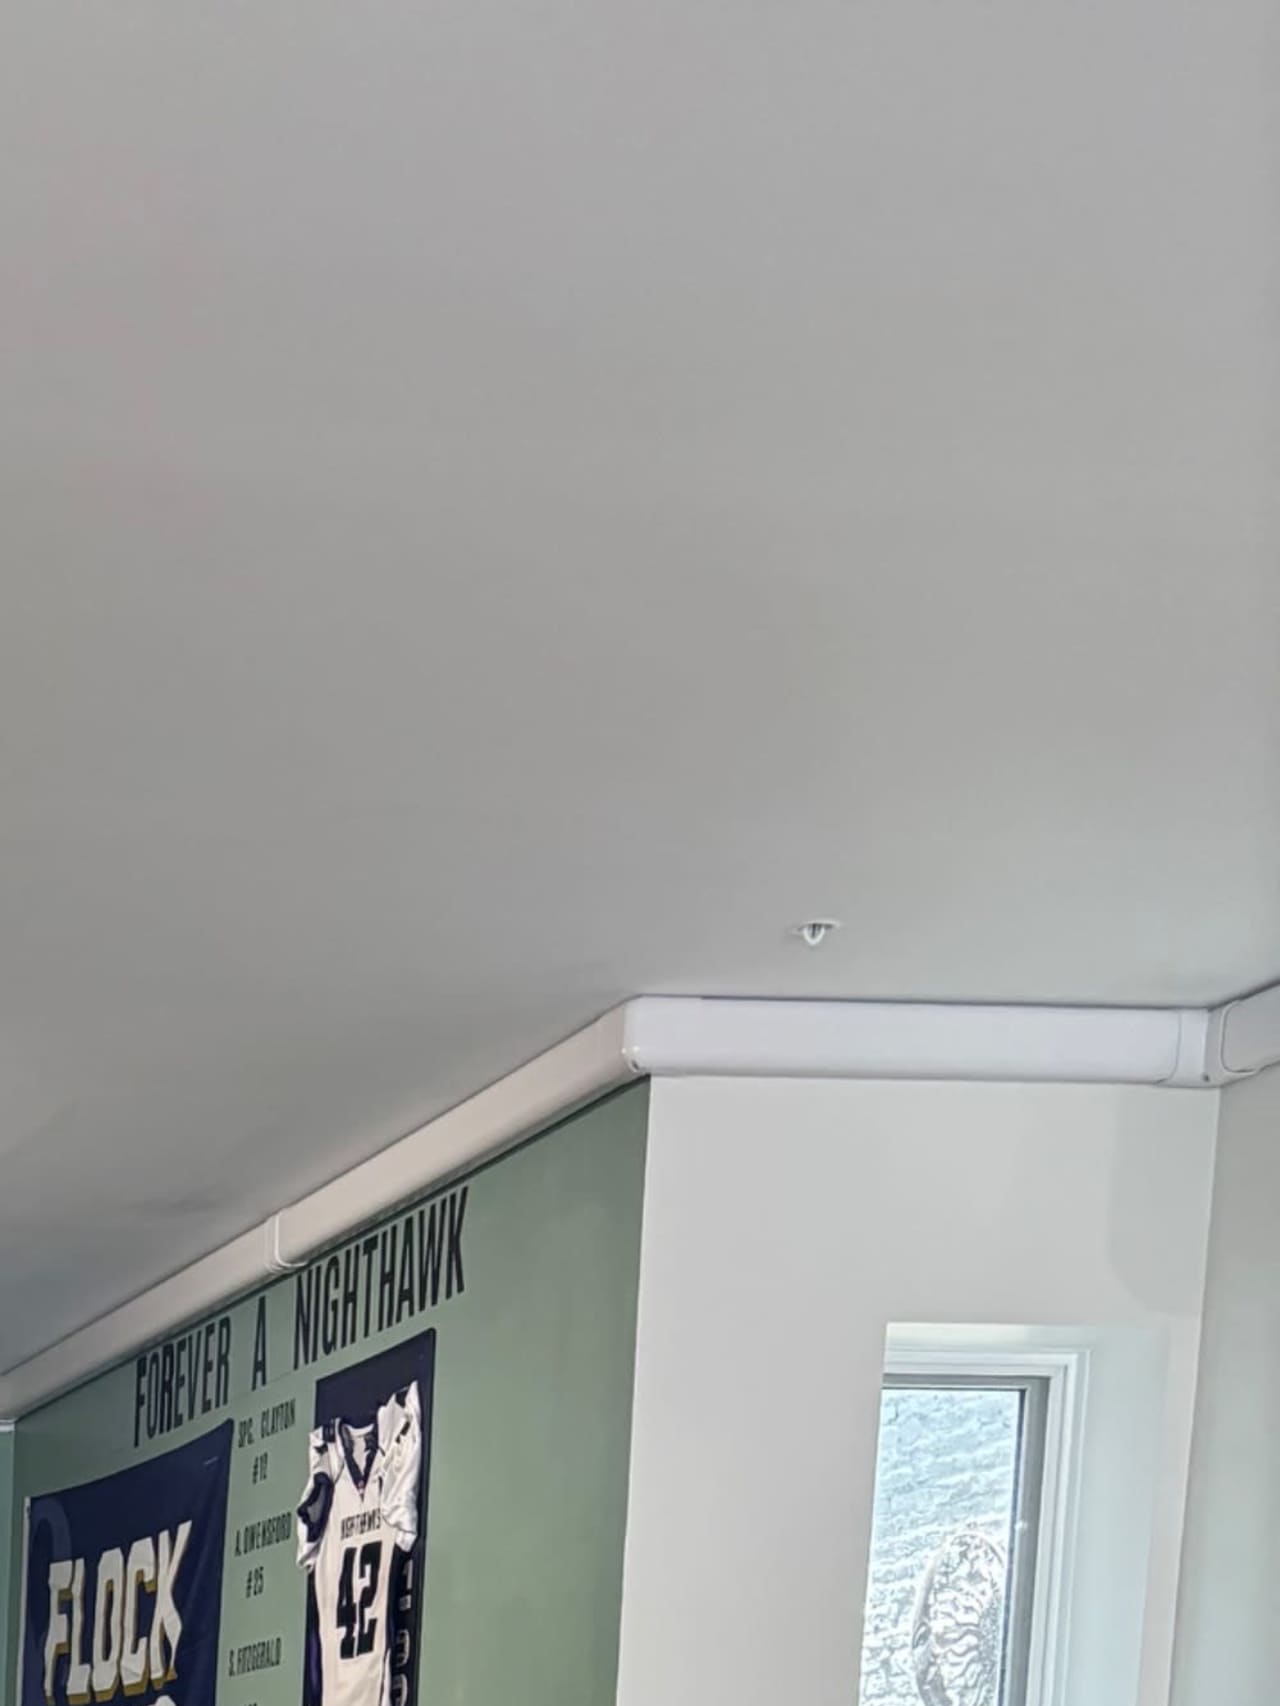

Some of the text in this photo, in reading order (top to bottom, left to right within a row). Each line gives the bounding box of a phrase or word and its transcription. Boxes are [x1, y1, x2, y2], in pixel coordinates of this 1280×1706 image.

[134, 1186, 468, 1448] FOREVER A NIGHTHAWK
[44, 1519, 193, 1702] FLOCK
[336, 1541, 383, 1660] 42
